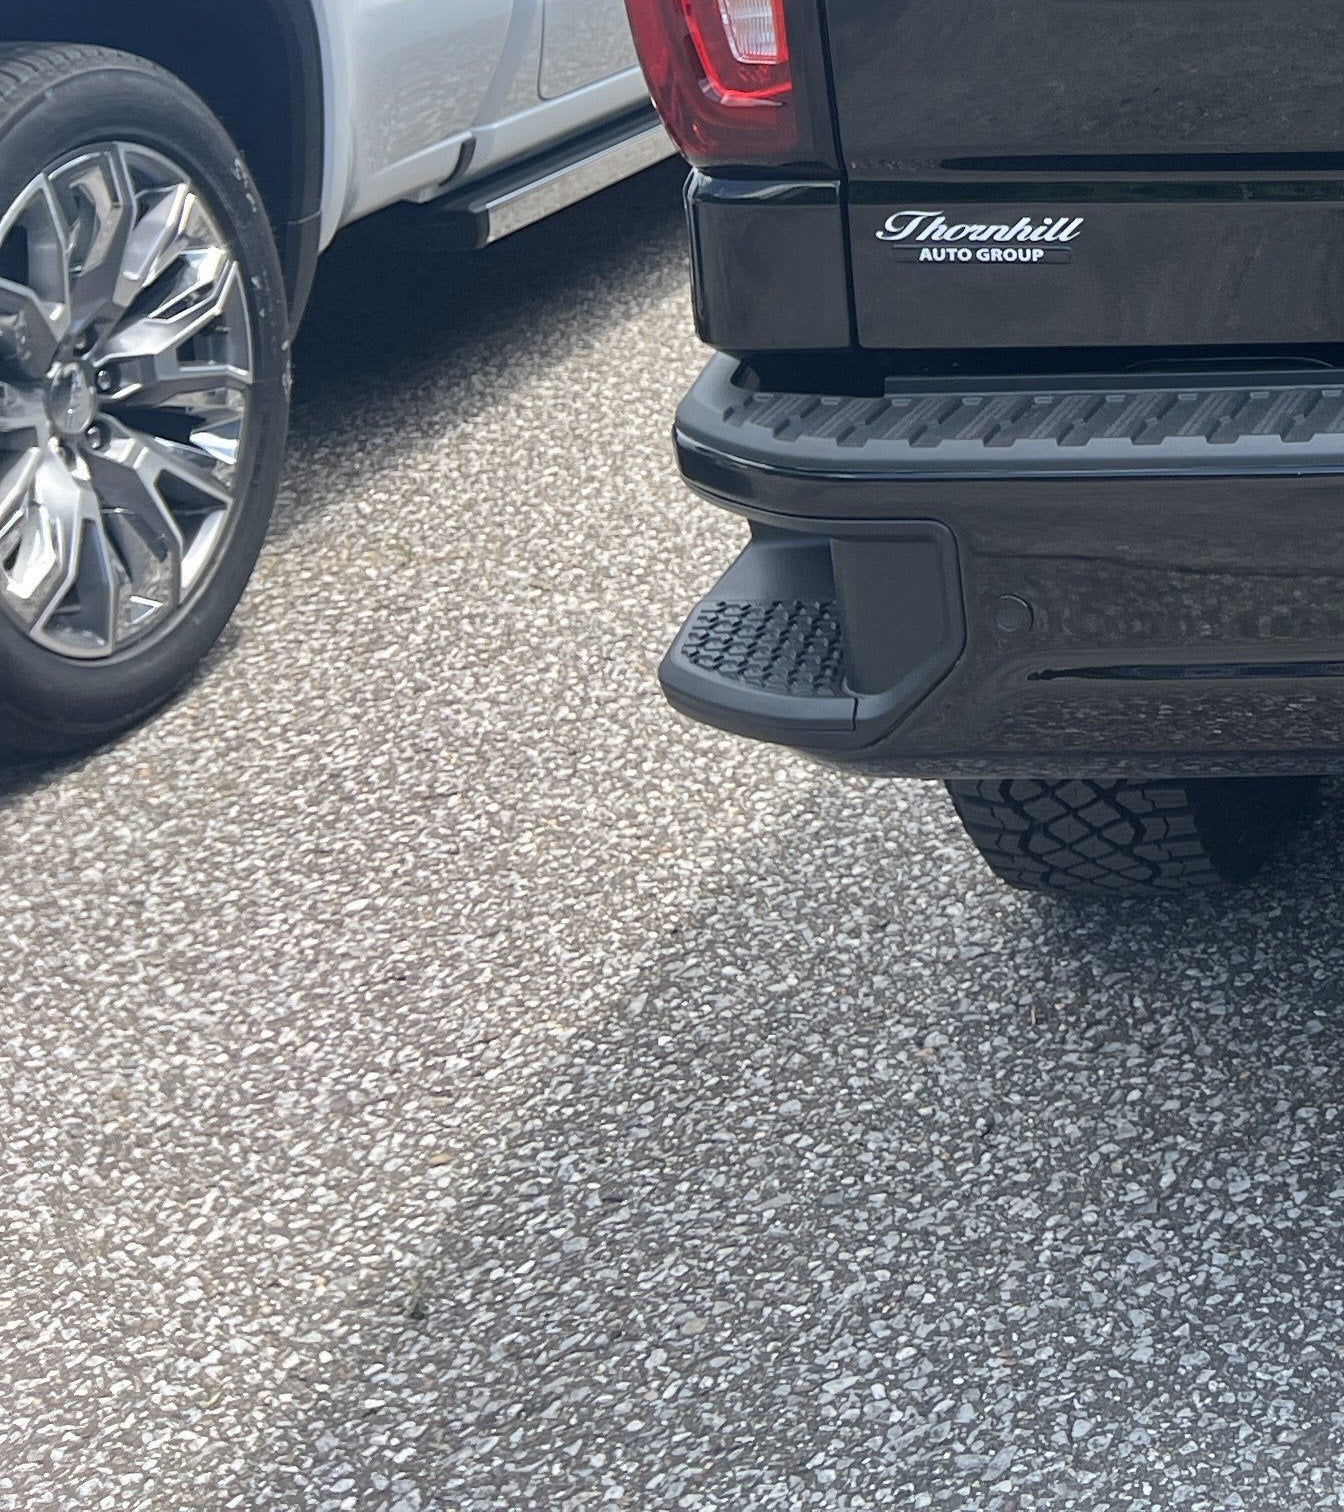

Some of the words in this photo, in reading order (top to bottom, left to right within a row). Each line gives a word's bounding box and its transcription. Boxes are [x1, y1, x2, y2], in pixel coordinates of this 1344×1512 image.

[875, 210, 1084, 242] Thornhill
[918, 247, 973, 262] AUTO
[975, 247, 1045, 262] GROUP
